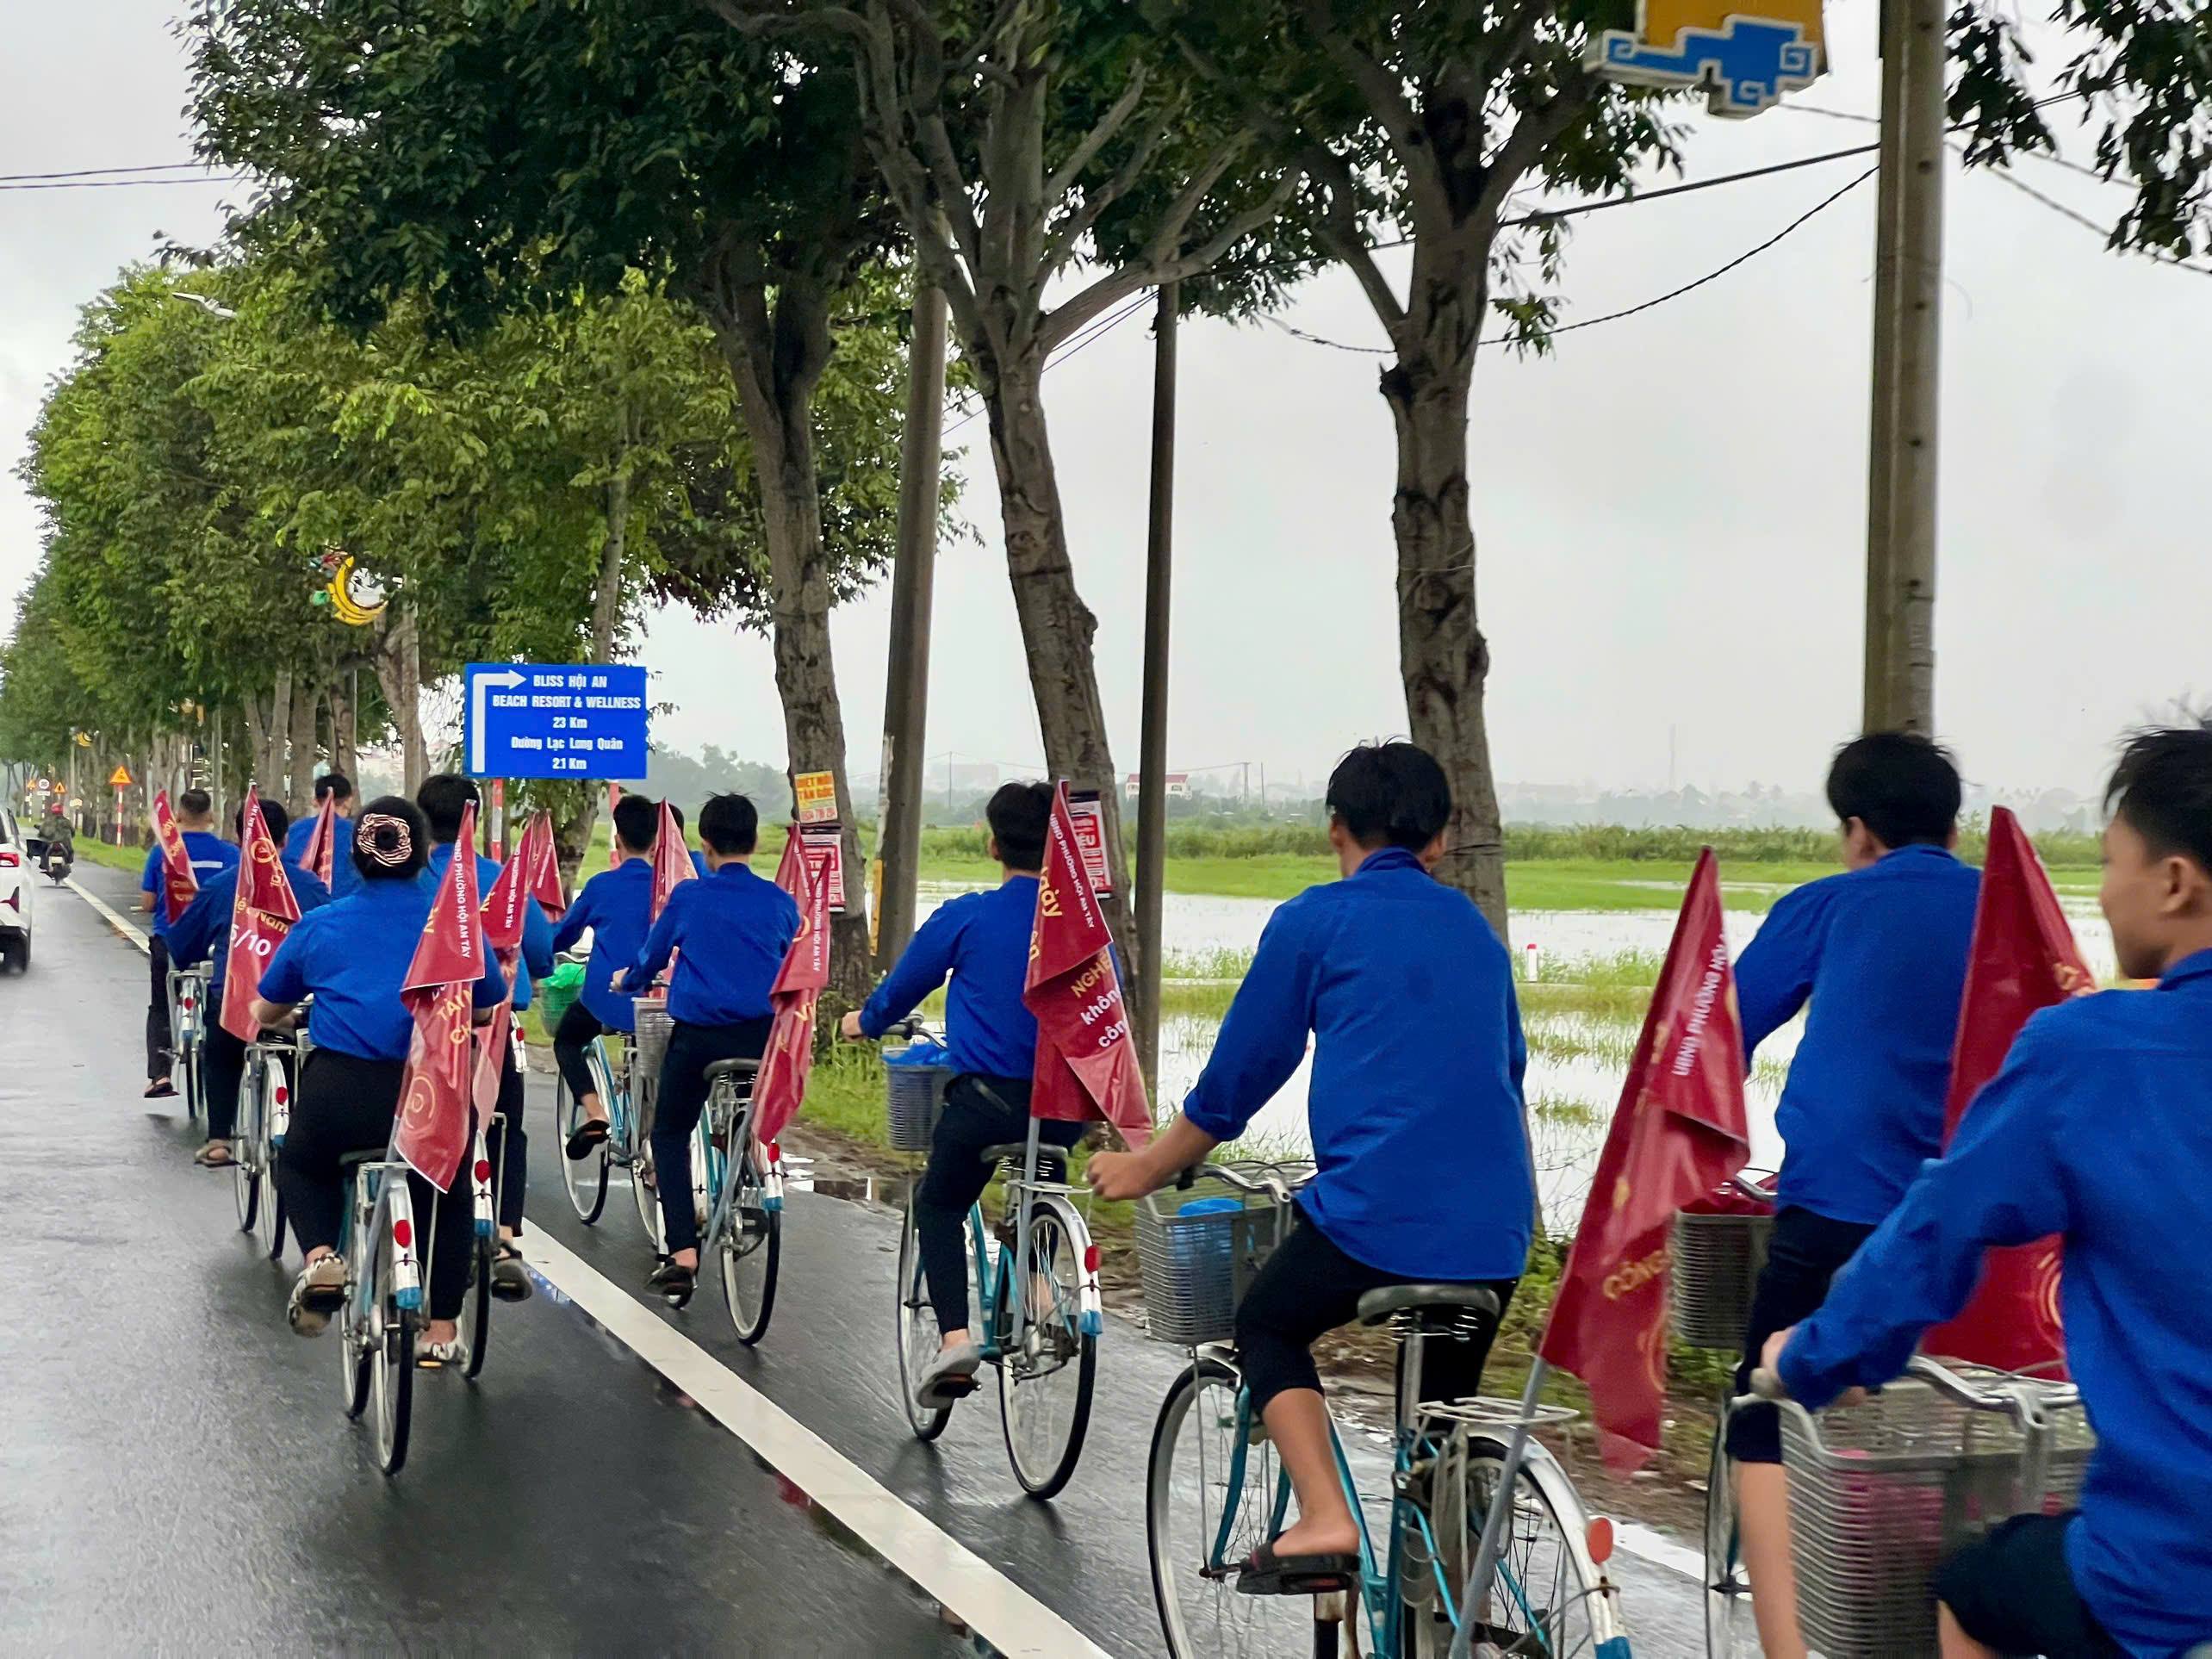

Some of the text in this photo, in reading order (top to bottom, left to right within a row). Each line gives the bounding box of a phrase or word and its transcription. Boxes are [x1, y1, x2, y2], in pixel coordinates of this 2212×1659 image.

[533, 674, 607, 690] BLISS HỘI AN
[493, 694, 642, 709] BEACH RESORT & WELLNESS
[552, 717, 587, 729] 23 Km
[547, 737, 565, 752] Lạc
[569, 737, 593, 750] Long
[597, 737, 624, 750] Quân
[552, 757, 587, 770] 21 Km
[455, 862, 467, 904] PHƯỜNG
[457, 904, 469, 923] HỘI
[458, 924, 469, 939] AN
[461, 939, 472, 958] TÂY
